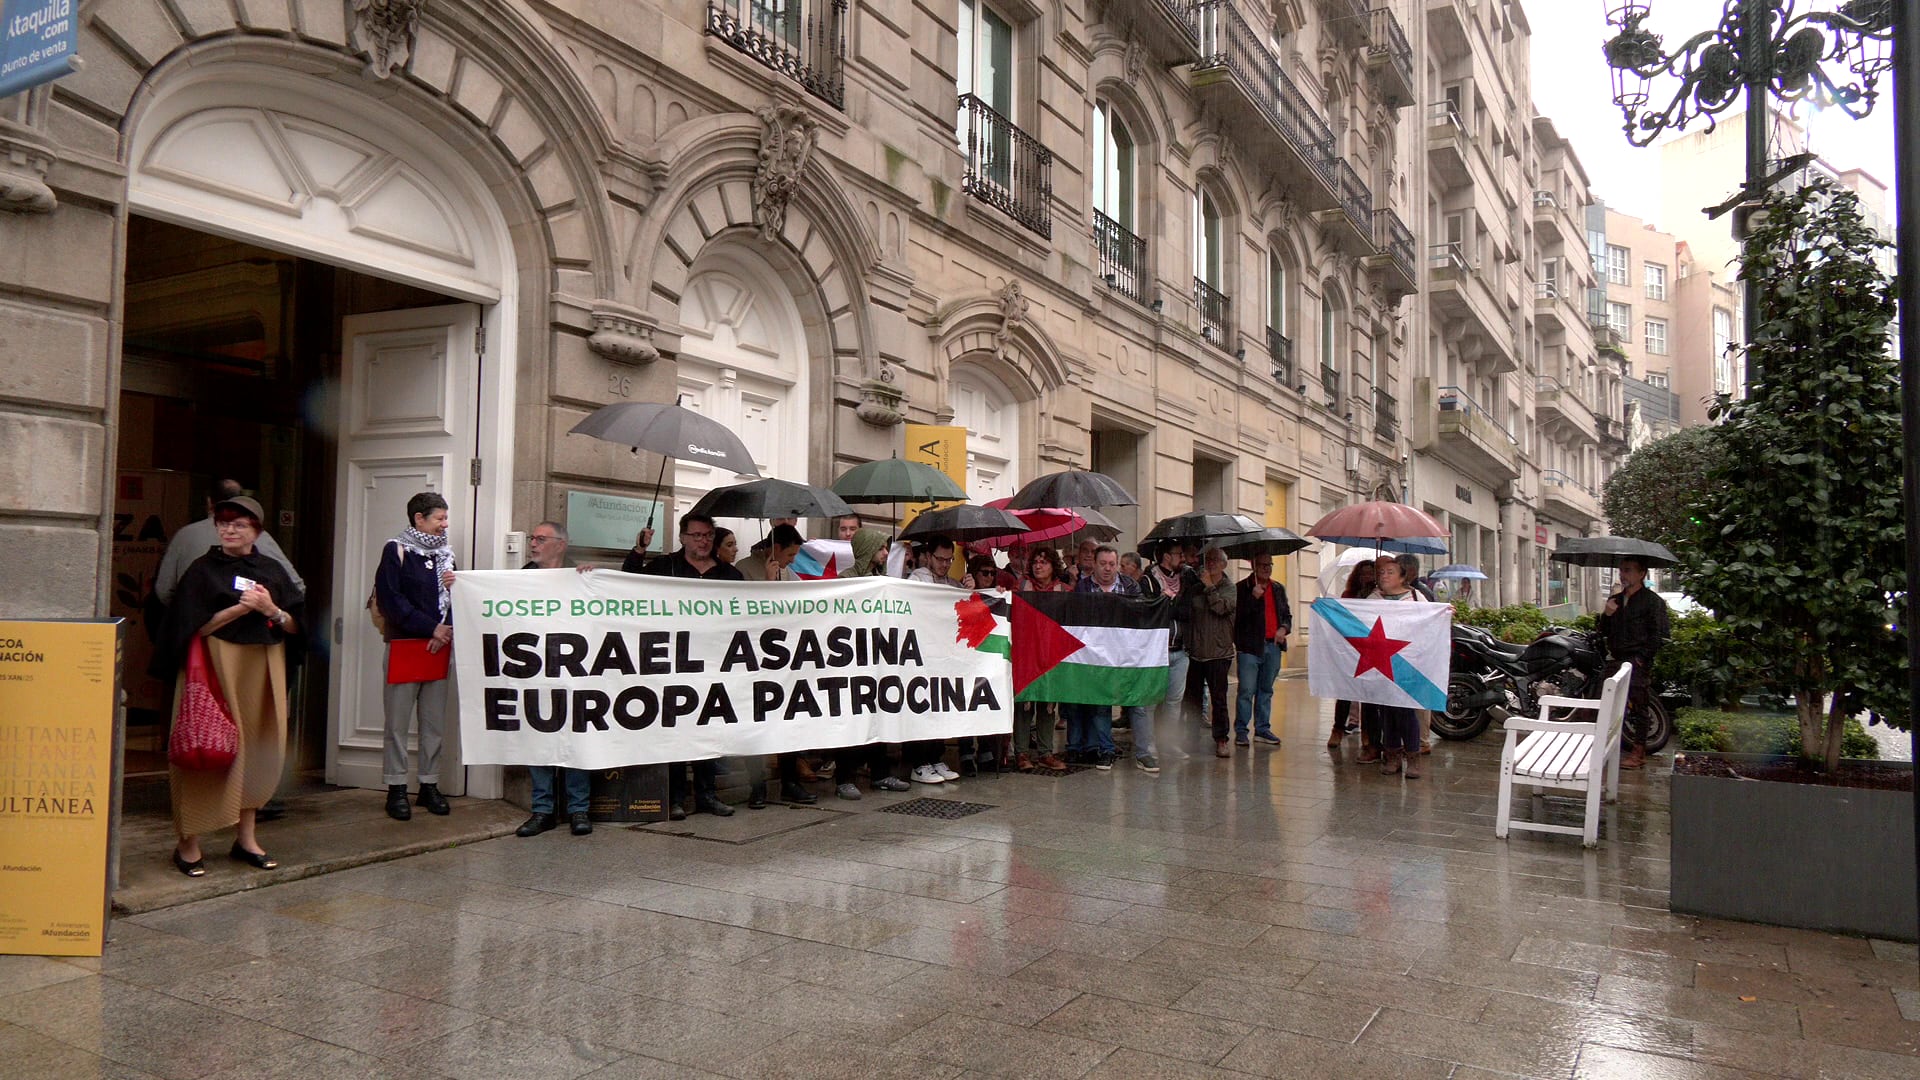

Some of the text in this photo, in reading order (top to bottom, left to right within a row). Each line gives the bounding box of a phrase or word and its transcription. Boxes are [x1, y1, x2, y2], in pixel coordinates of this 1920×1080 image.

[41, 19, 69, 40] .com
[1, 41, 67, 76] punto de venta
[608, 374, 631, 397] 26
[482, 597, 912, 617] JOSEP BORRELL NON É BENVIDO NA GALIZA
[482, 626, 923, 679] ISRAEL ASASINA
[484, 675, 1001, 733] EUROPA PATROCINA
